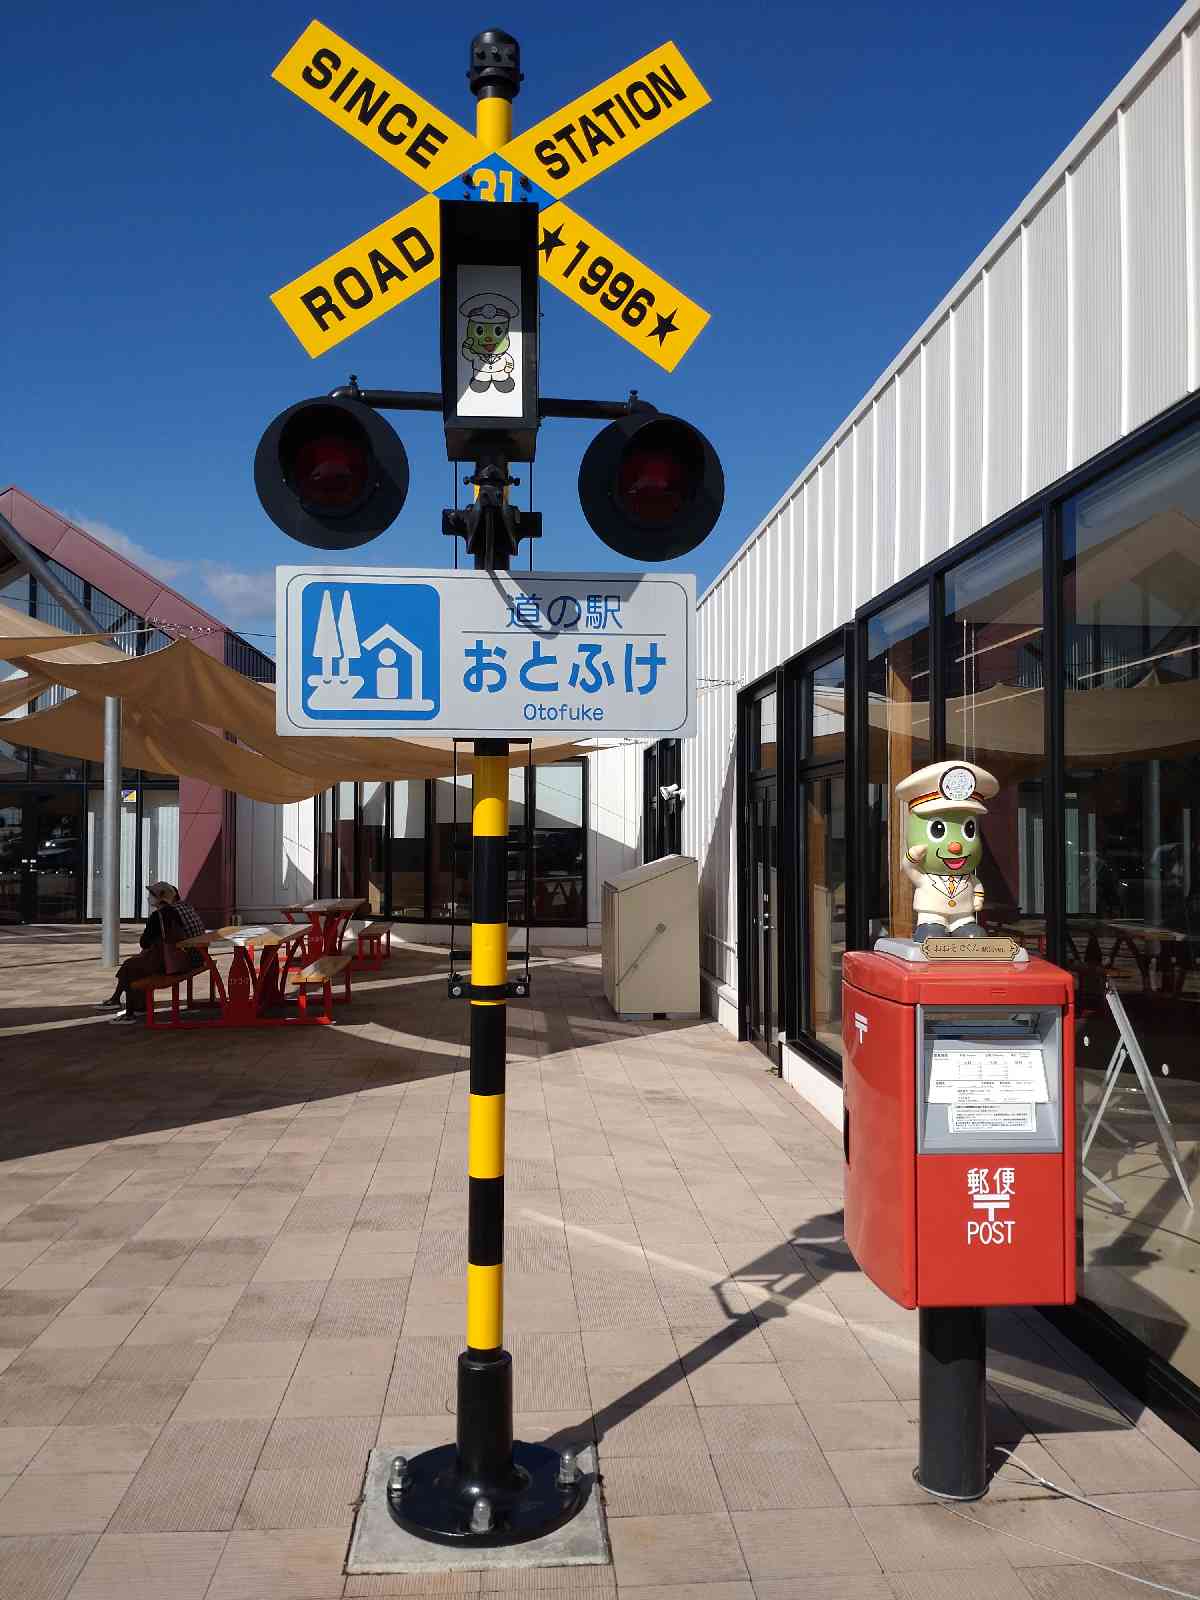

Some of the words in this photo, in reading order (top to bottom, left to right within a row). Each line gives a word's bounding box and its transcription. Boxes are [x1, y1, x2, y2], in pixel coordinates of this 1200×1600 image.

[301, 48, 449, 169] SINCE
[534, 64, 687, 181] STATION
[472, 168, 513, 202] 31
[300, 226, 435, 331] ROAD
[505, 593, 622, 629] 道の駅
[463, 639, 667, 695] おとふけ
[524, 703, 604, 721] Otofuke
[967, 1168, 1016, 1195] 郵便
[967, 1221, 1016, 1245] POST
